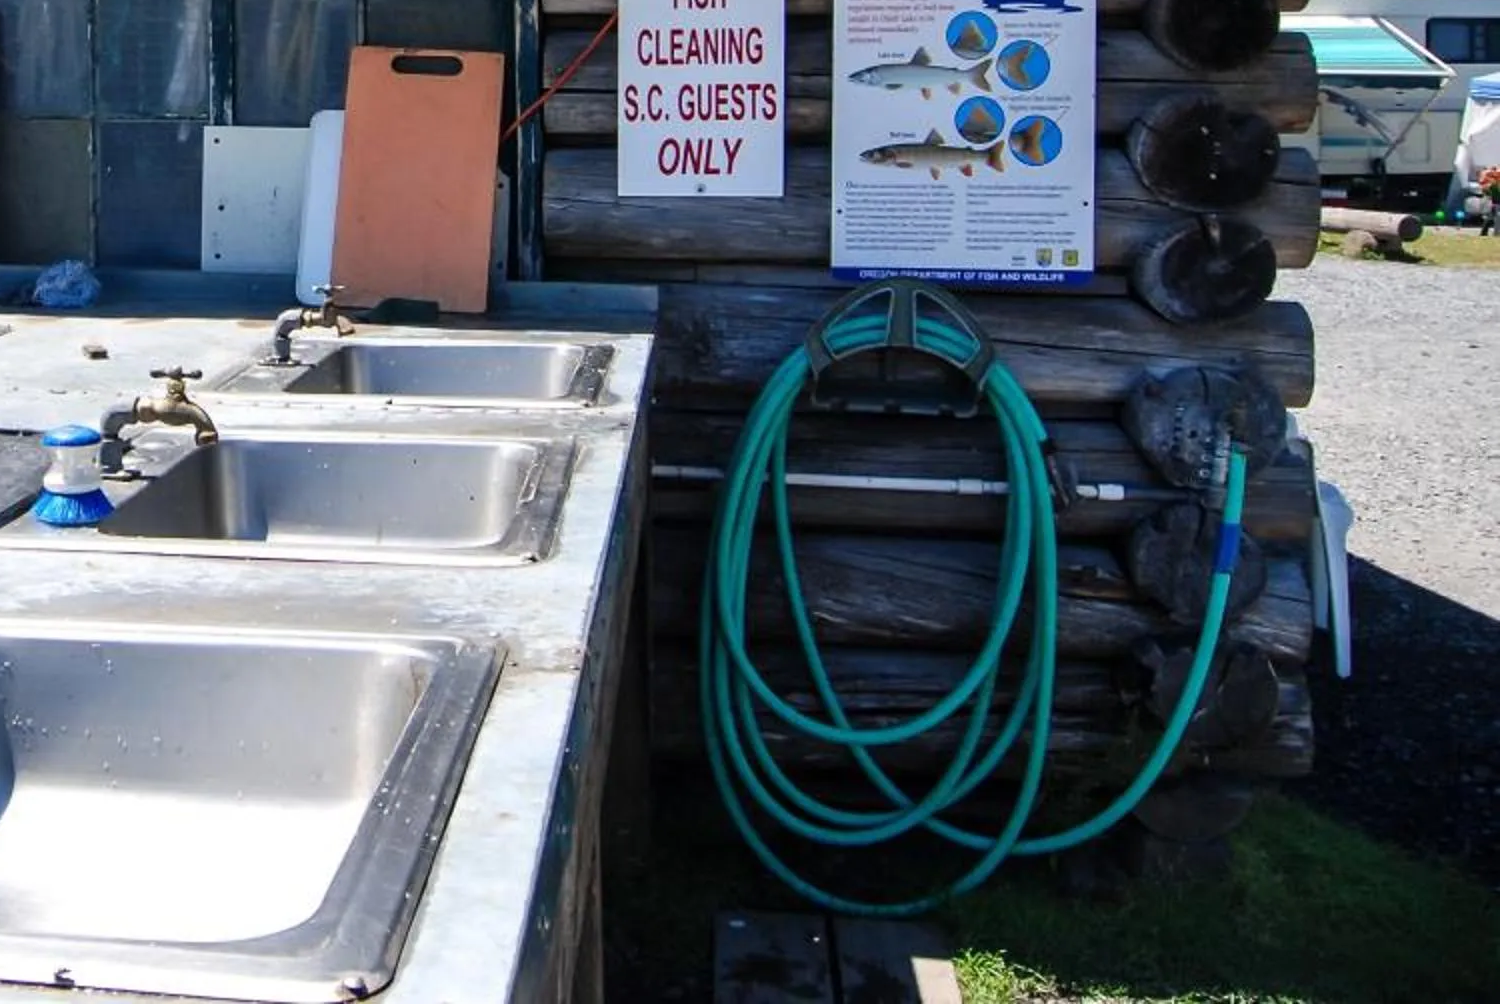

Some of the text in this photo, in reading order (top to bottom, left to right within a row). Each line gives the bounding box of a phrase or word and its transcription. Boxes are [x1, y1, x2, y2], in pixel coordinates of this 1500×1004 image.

[638, 28, 762, 66] CLEANING
[624, 84, 776, 121] S.C. GUESTS
[658, 138, 742, 175] ONLY
[978, 272, 999, 281] FISH
[1001, 273, 1020, 281] AND
